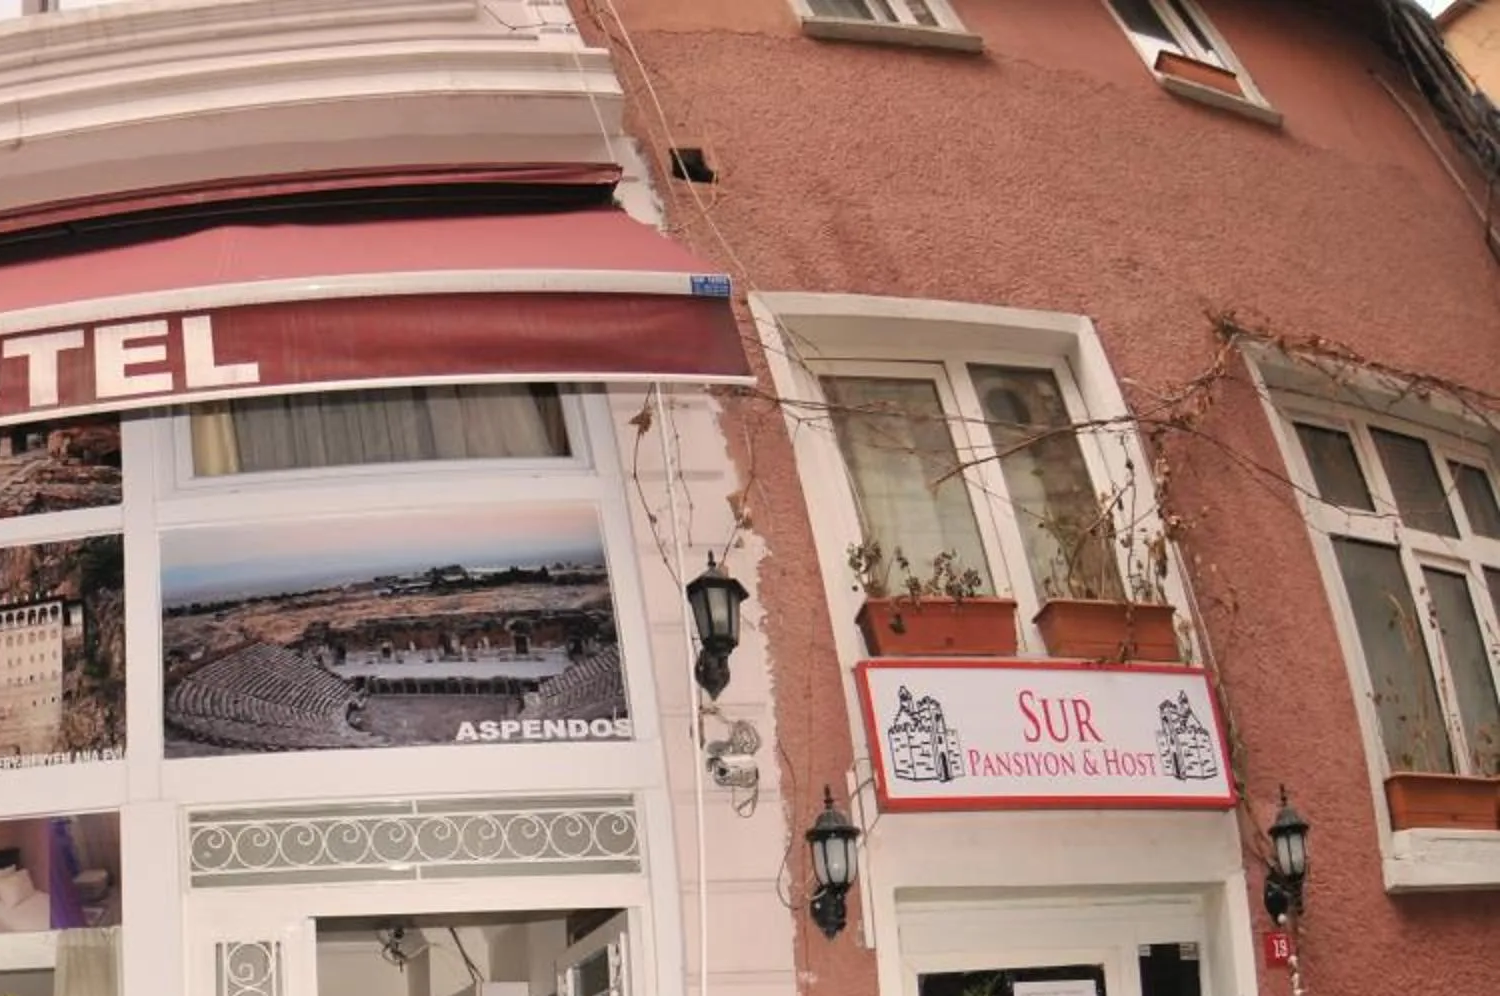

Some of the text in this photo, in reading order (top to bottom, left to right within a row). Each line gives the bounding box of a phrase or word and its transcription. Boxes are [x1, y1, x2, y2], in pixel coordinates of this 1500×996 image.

[455, 717, 632, 741] ASPENDOS
[1018, 689, 1104, 743] SUR
[1083, 749, 1100, 776] &
[1103, 749, 1157, 777] HOST
